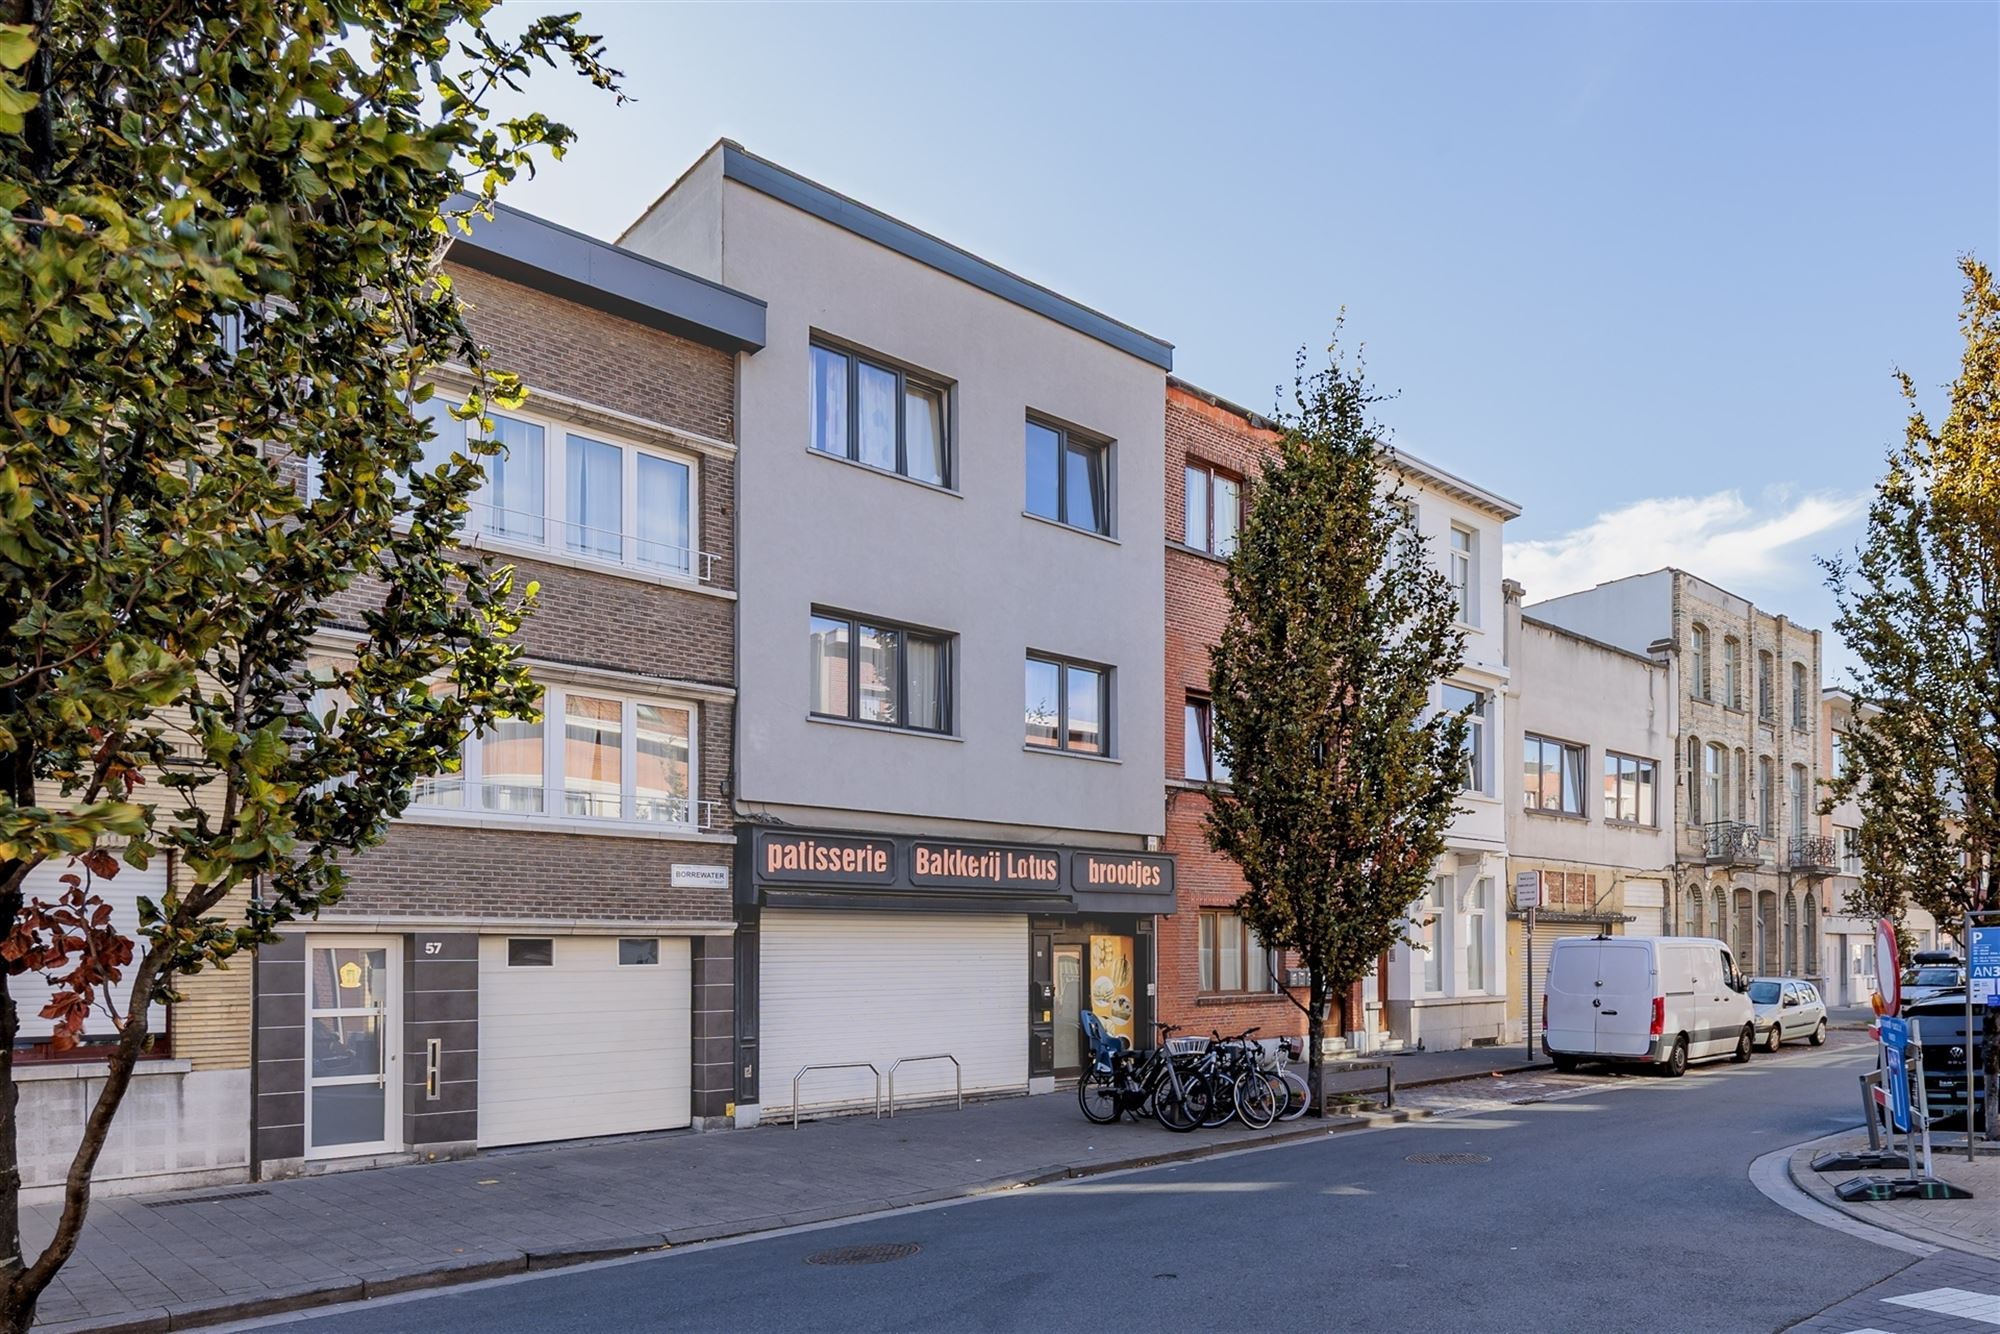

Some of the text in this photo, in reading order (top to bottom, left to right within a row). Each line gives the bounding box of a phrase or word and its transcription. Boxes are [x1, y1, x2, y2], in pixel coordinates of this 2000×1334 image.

[767, 841, 887, 872] patisserie
[916, 847, 1057, 881] Bakkerij Lotus
[1088, 858, 1160, 888] broodjes
[425, 942, 442, 954] 57
[1973, 931, 1983, 944] P
